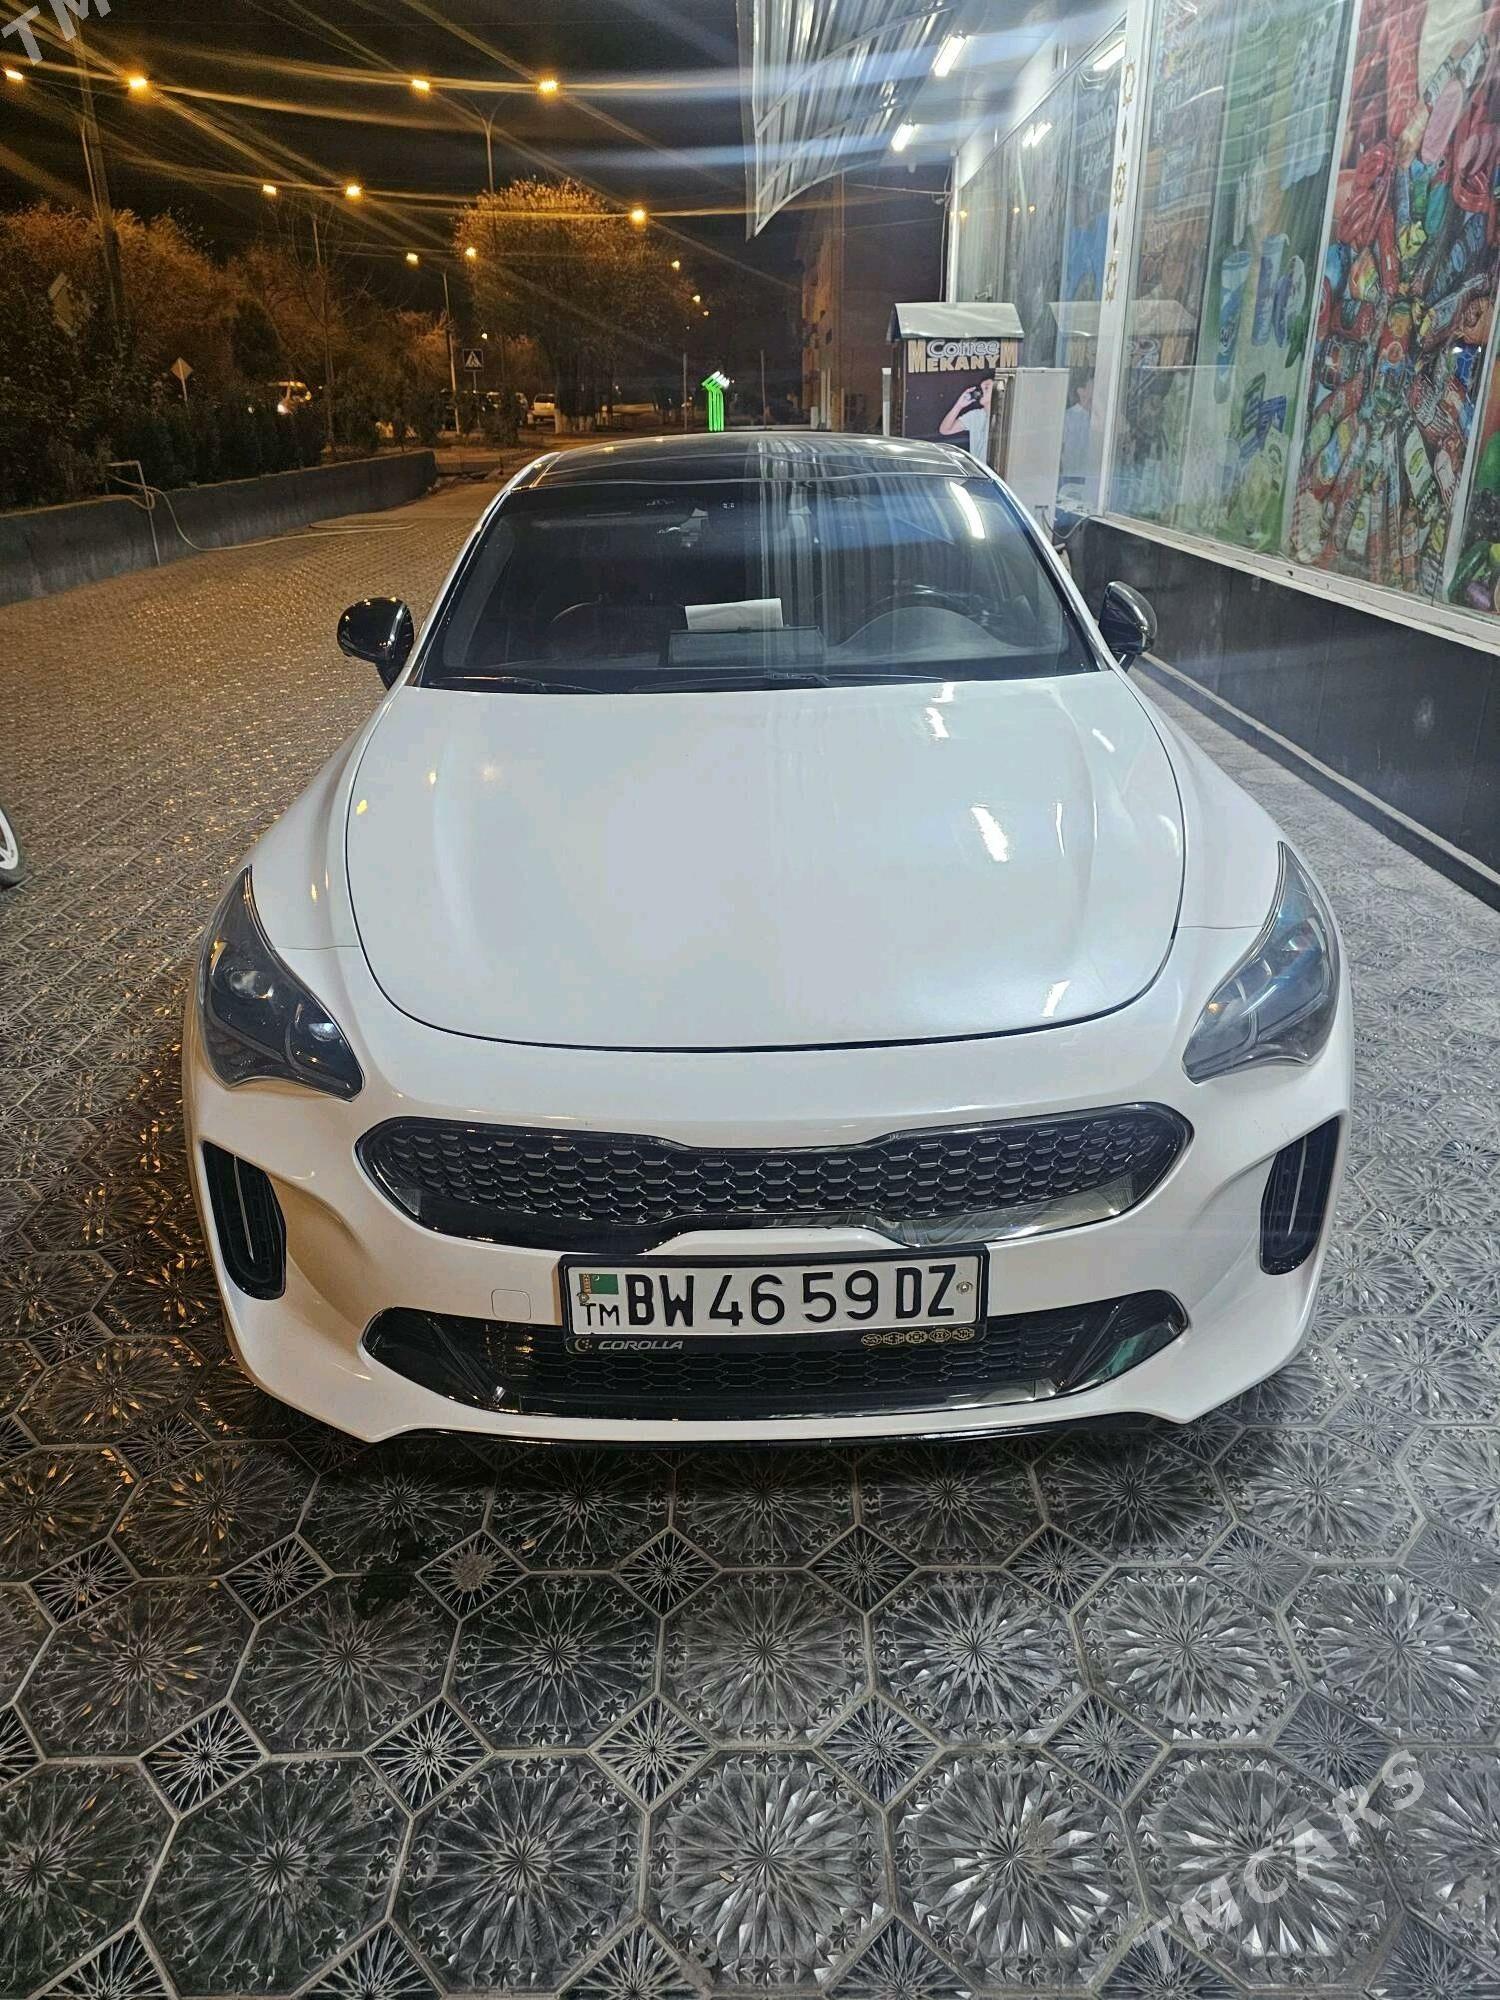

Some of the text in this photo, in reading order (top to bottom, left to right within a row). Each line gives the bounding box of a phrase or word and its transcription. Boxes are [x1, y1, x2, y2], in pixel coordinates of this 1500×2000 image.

[927, 339, 1000, 358] Coffee
[580, 1303, 620, 1326] TM
[598, 1339, 684, 1351] COROLLA
